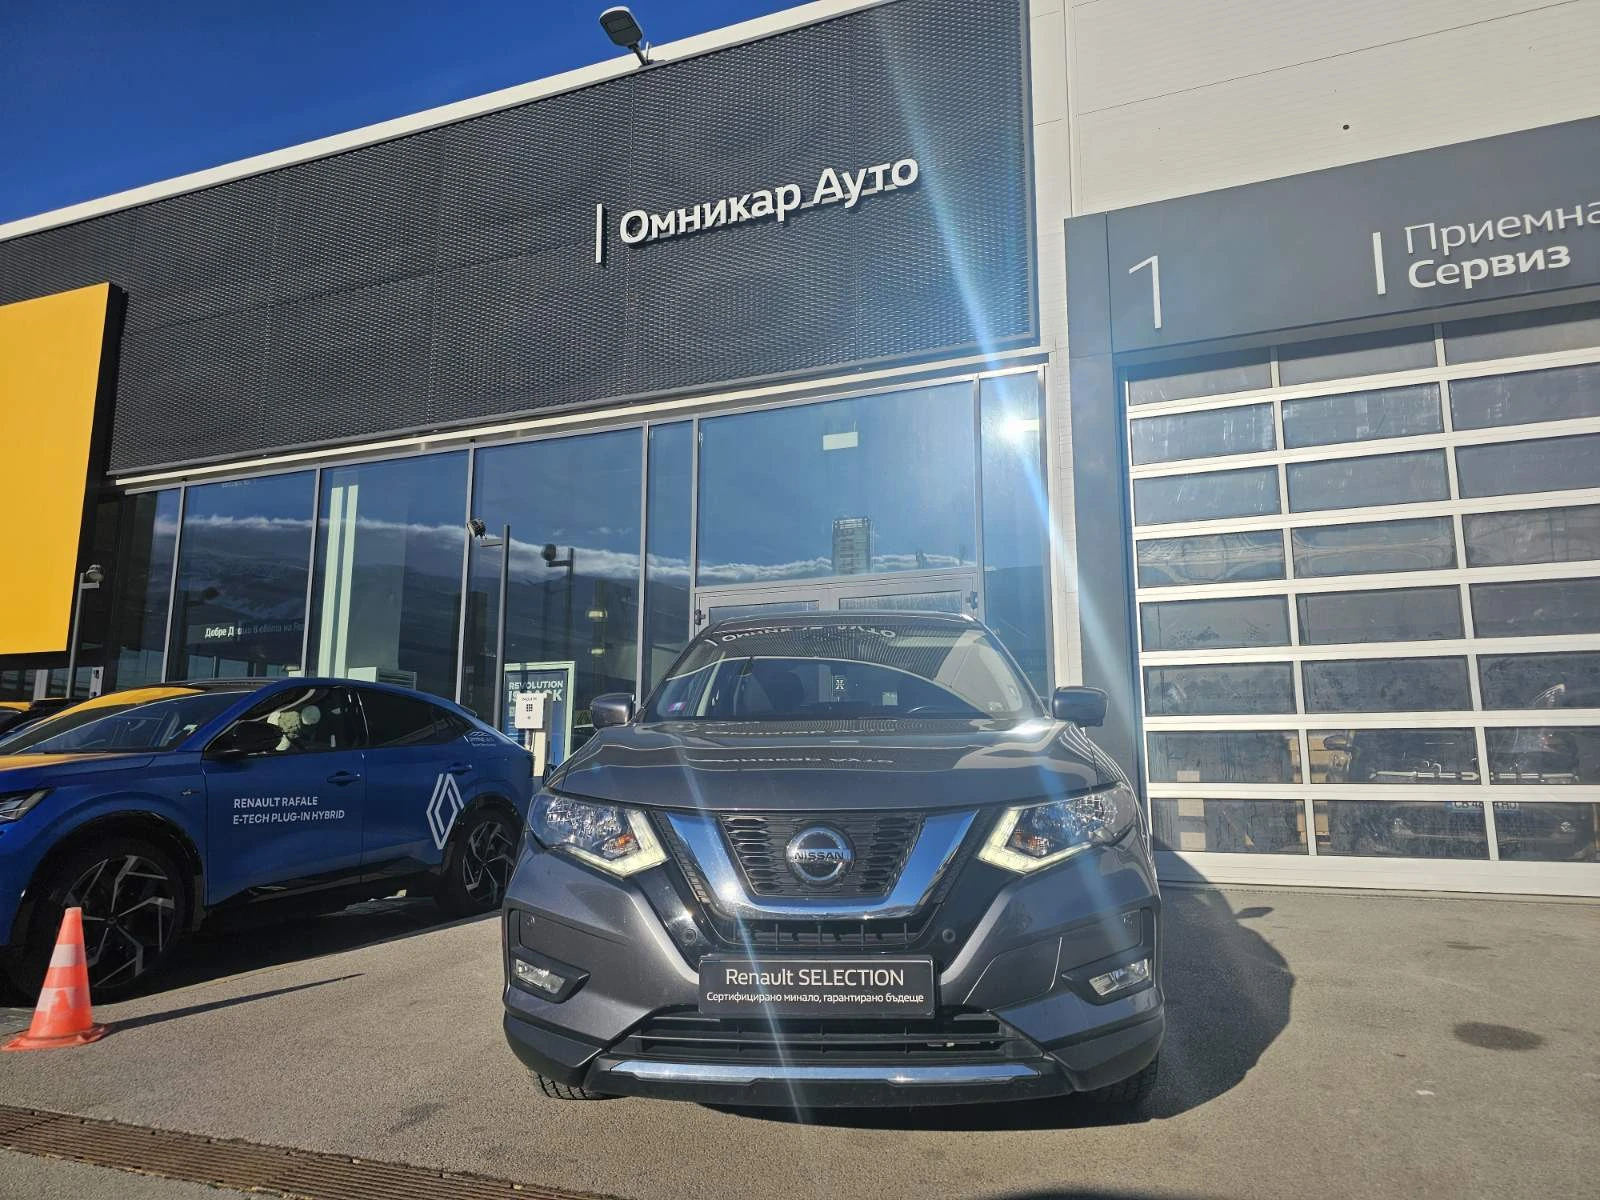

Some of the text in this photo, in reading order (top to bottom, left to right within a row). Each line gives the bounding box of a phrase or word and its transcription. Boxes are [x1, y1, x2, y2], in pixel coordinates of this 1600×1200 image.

[619, 158, 918, 243] Омникар Ауто
[1408, 245, 1571, 289] Сервиз
[1128, 255, 1162, 329] 1
[509, 680, 564, 690] REVOLUTION
[233, 796, 319, 809] RENAULT RAFALE
[233, 810, 345, 825] E-TECH PLUG-IN HYBRID
[794, 851, 844, 860] NISSAN
[726, 968, 904, 986] Renault SELECTION
[706, 992, 925, 1004] Сертифицирано минало, гарантирано бъдеще
